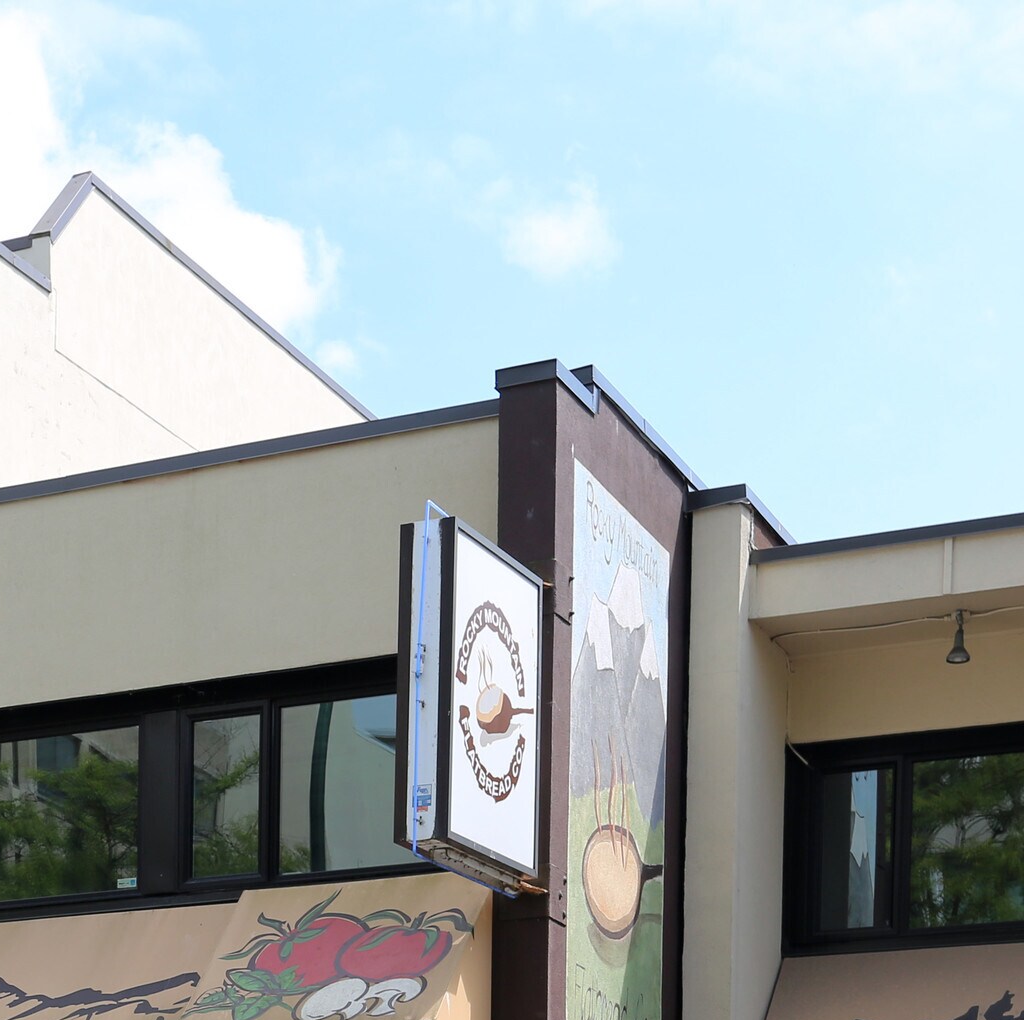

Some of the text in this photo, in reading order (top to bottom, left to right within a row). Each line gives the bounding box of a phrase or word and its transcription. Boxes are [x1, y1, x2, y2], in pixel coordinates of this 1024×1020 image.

[586, 481, 659, 589] Rocky Mountain
[459, 608, 524, 690] ROCKY MOUNTAIN
[461, 717, 524, 796] FLATBREAD CO.
